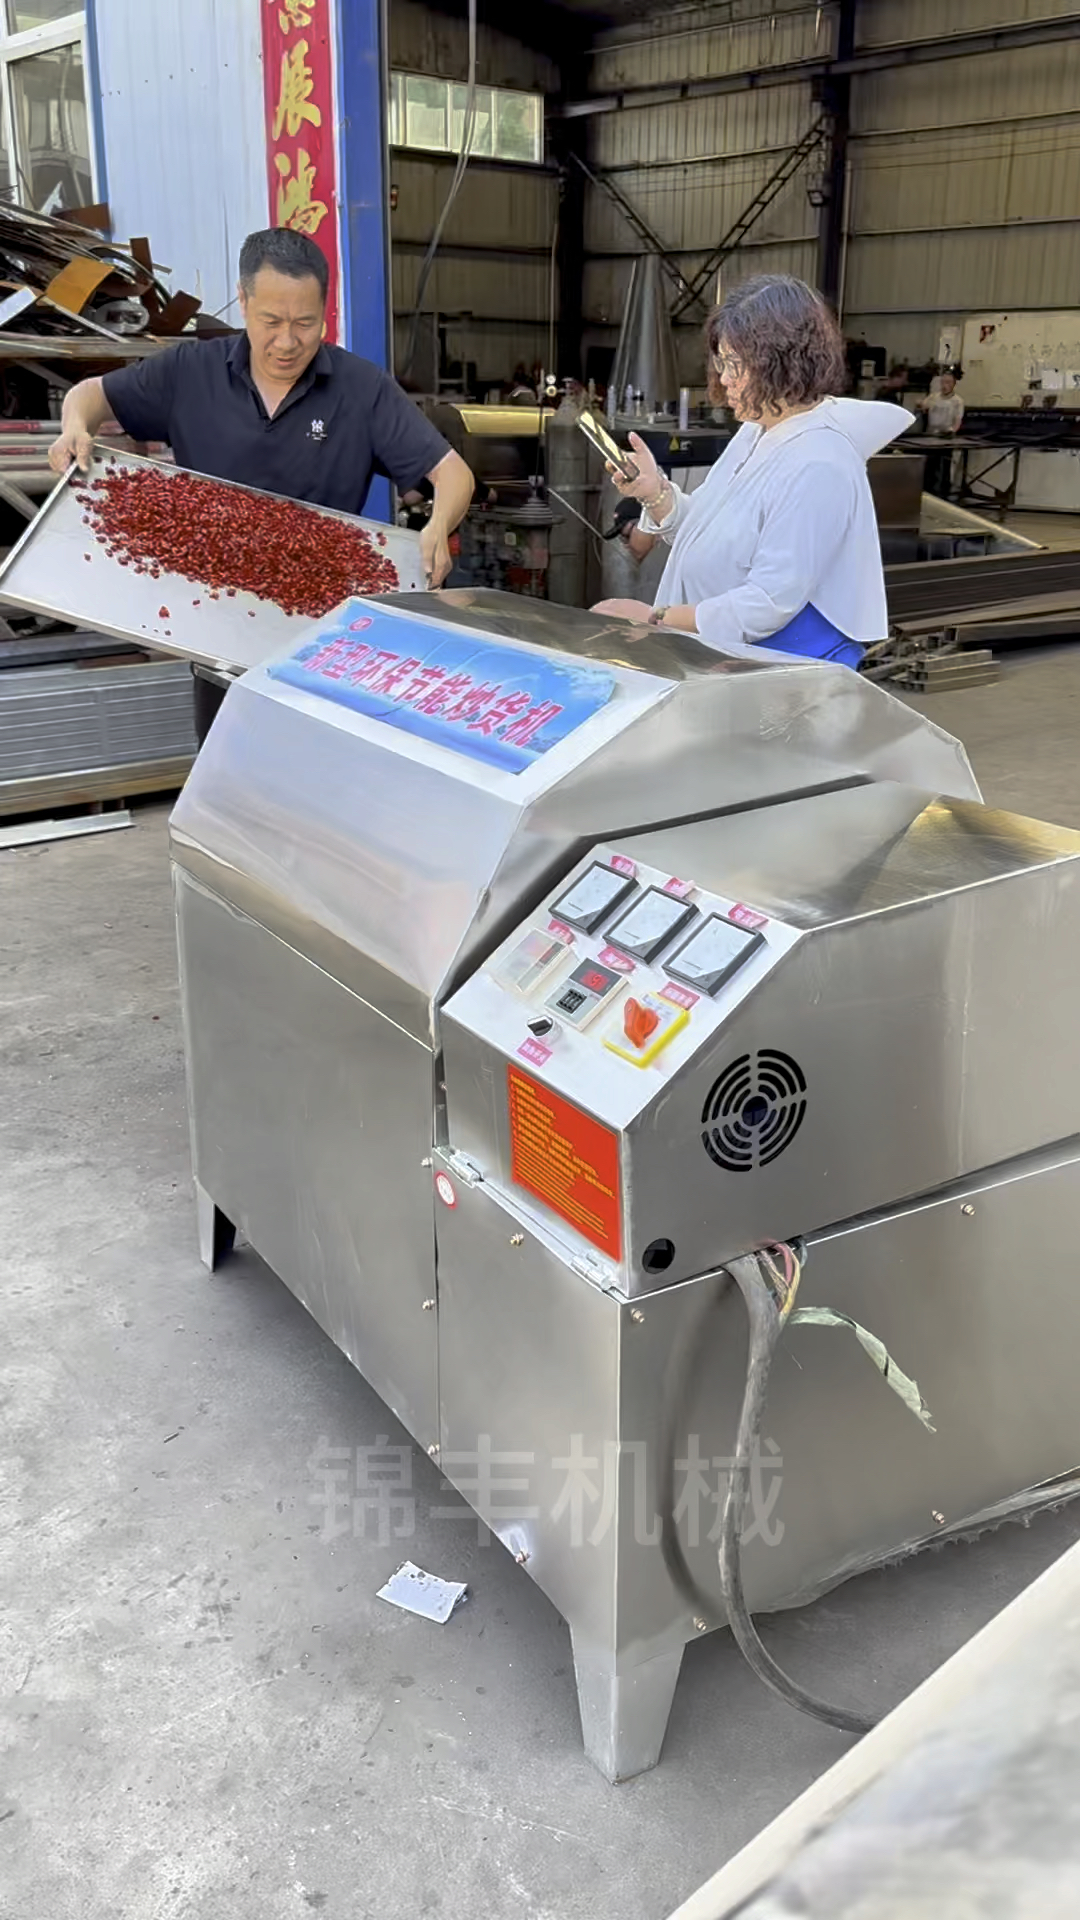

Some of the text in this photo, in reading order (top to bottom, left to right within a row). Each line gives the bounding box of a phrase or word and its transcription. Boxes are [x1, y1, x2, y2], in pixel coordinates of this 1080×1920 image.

[301, 636, 566, 748] 新型环保节能炒货机
